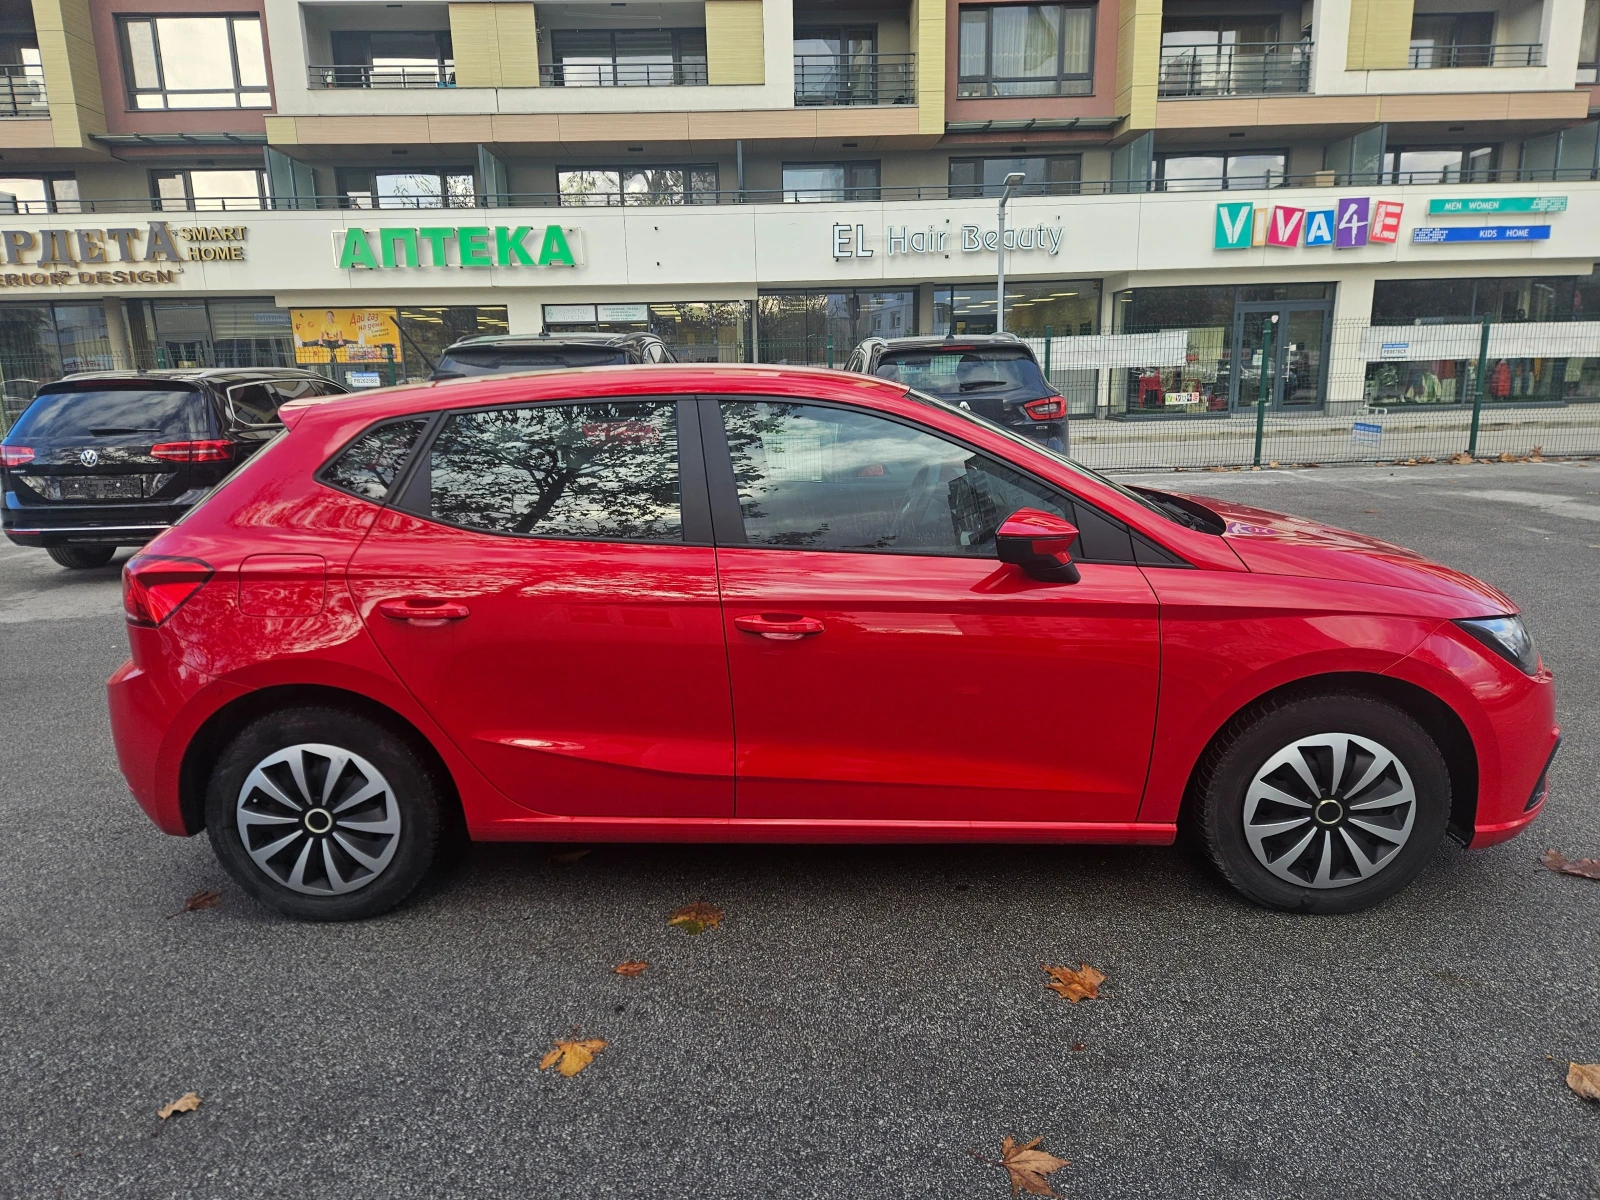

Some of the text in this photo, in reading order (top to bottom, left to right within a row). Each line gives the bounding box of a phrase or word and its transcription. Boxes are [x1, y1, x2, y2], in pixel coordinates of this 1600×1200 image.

[1444, 201, 1500, 210] MEN WOMEN
[1217, 201, 1402, 246] VIVA4E
[178, 225, 248, 242] SMART
[832, 222, 1065, 258] EL Hair Beauty
[1479, 228, 1529, 238] KIDS HOME
[187, 245, 245, 262] HOME
[339, 225, 575, 268] АПТЕКА
[0, 269, 176, 286] RIOR DESIGN
